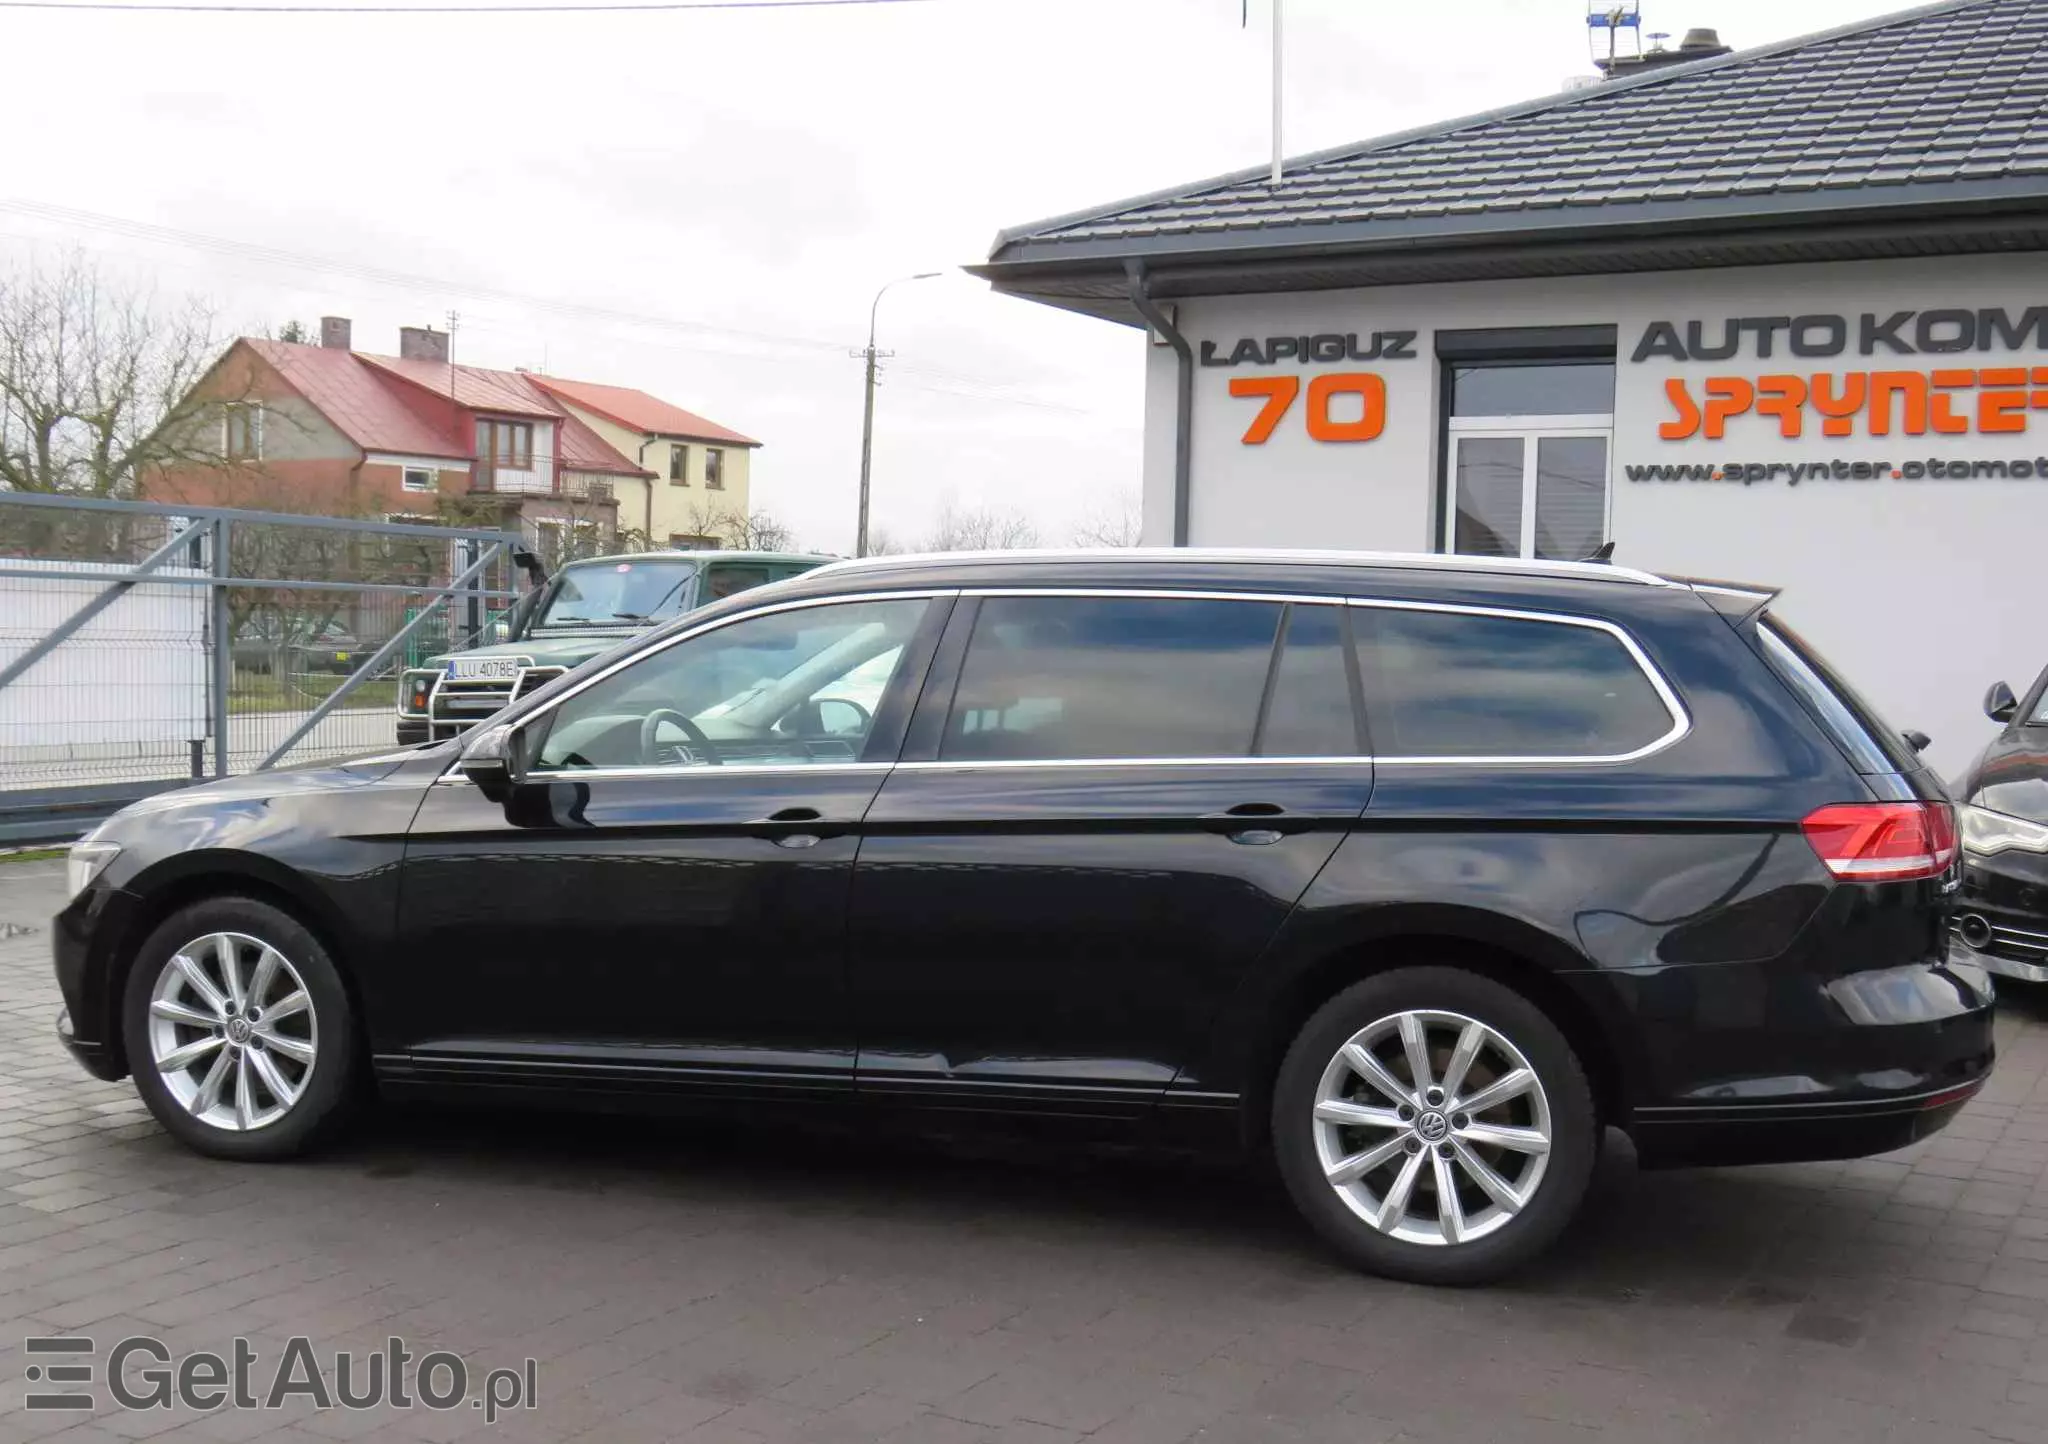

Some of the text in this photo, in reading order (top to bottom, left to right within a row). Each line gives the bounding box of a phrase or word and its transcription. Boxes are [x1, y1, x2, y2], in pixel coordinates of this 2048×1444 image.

[1201, 330, 1417, 367] ŁAPIGUZ
[1631, 305, 2048, 362] AUTO KOM
[1228, 372, 1387, 445] 70
[456, 661, 514, 677] LLU 4078E
